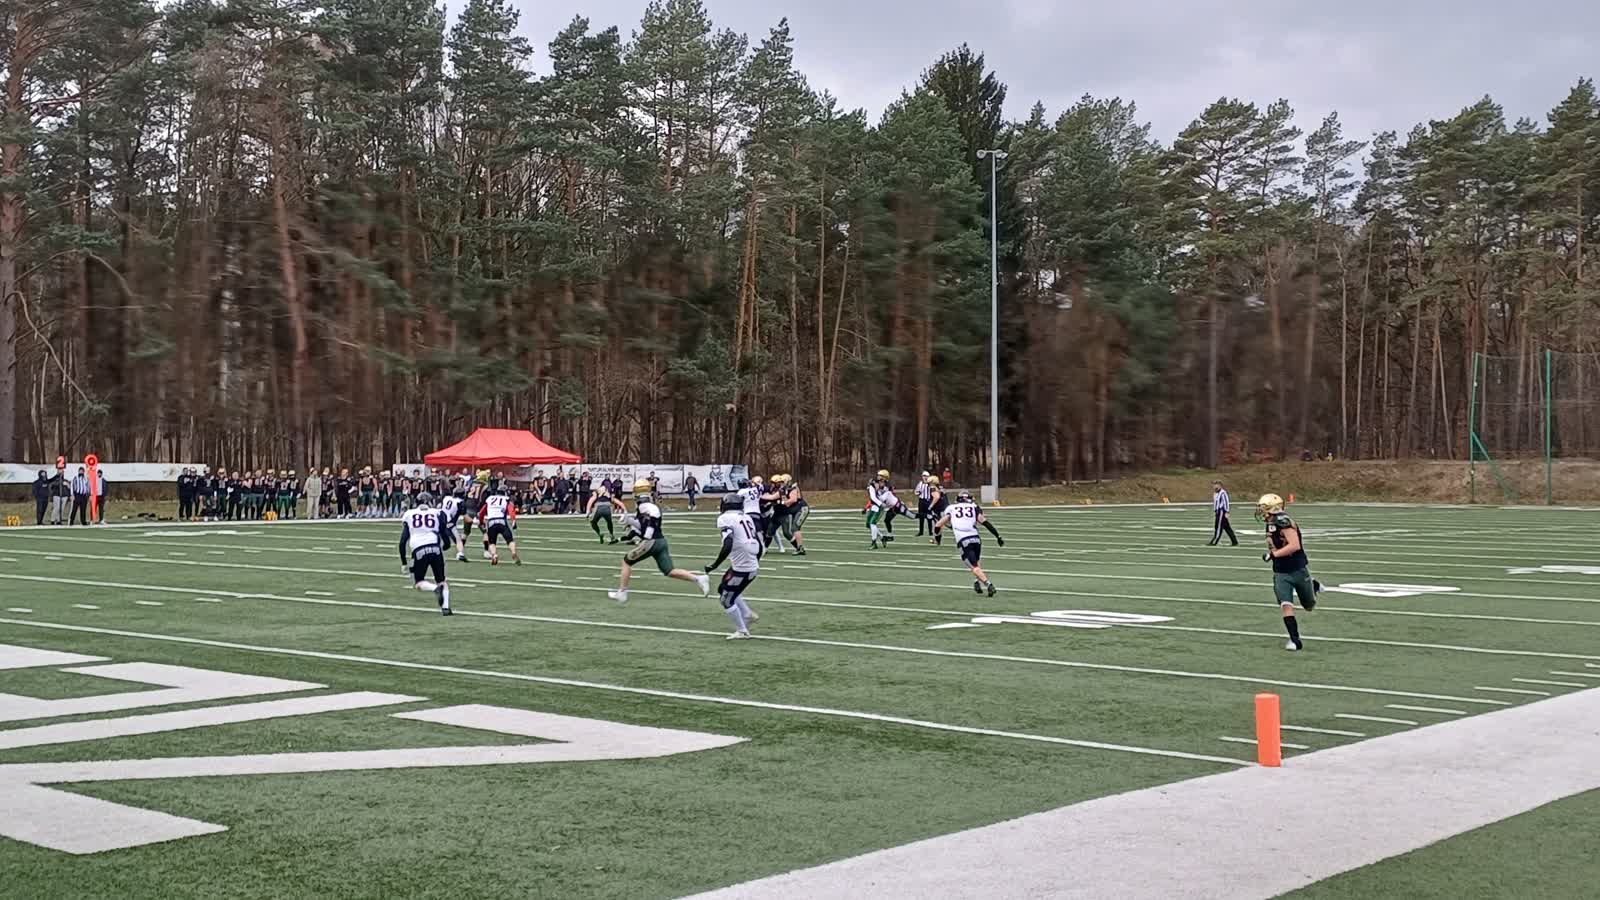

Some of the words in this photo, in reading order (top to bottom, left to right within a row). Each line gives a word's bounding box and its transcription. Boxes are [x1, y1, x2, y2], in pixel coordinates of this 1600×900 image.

[445, 500, 453, 510] 9
[490, 497, 503, 506] 21
[954, 506, 974, 518] 33
[412, 513, 436, 529] 86
